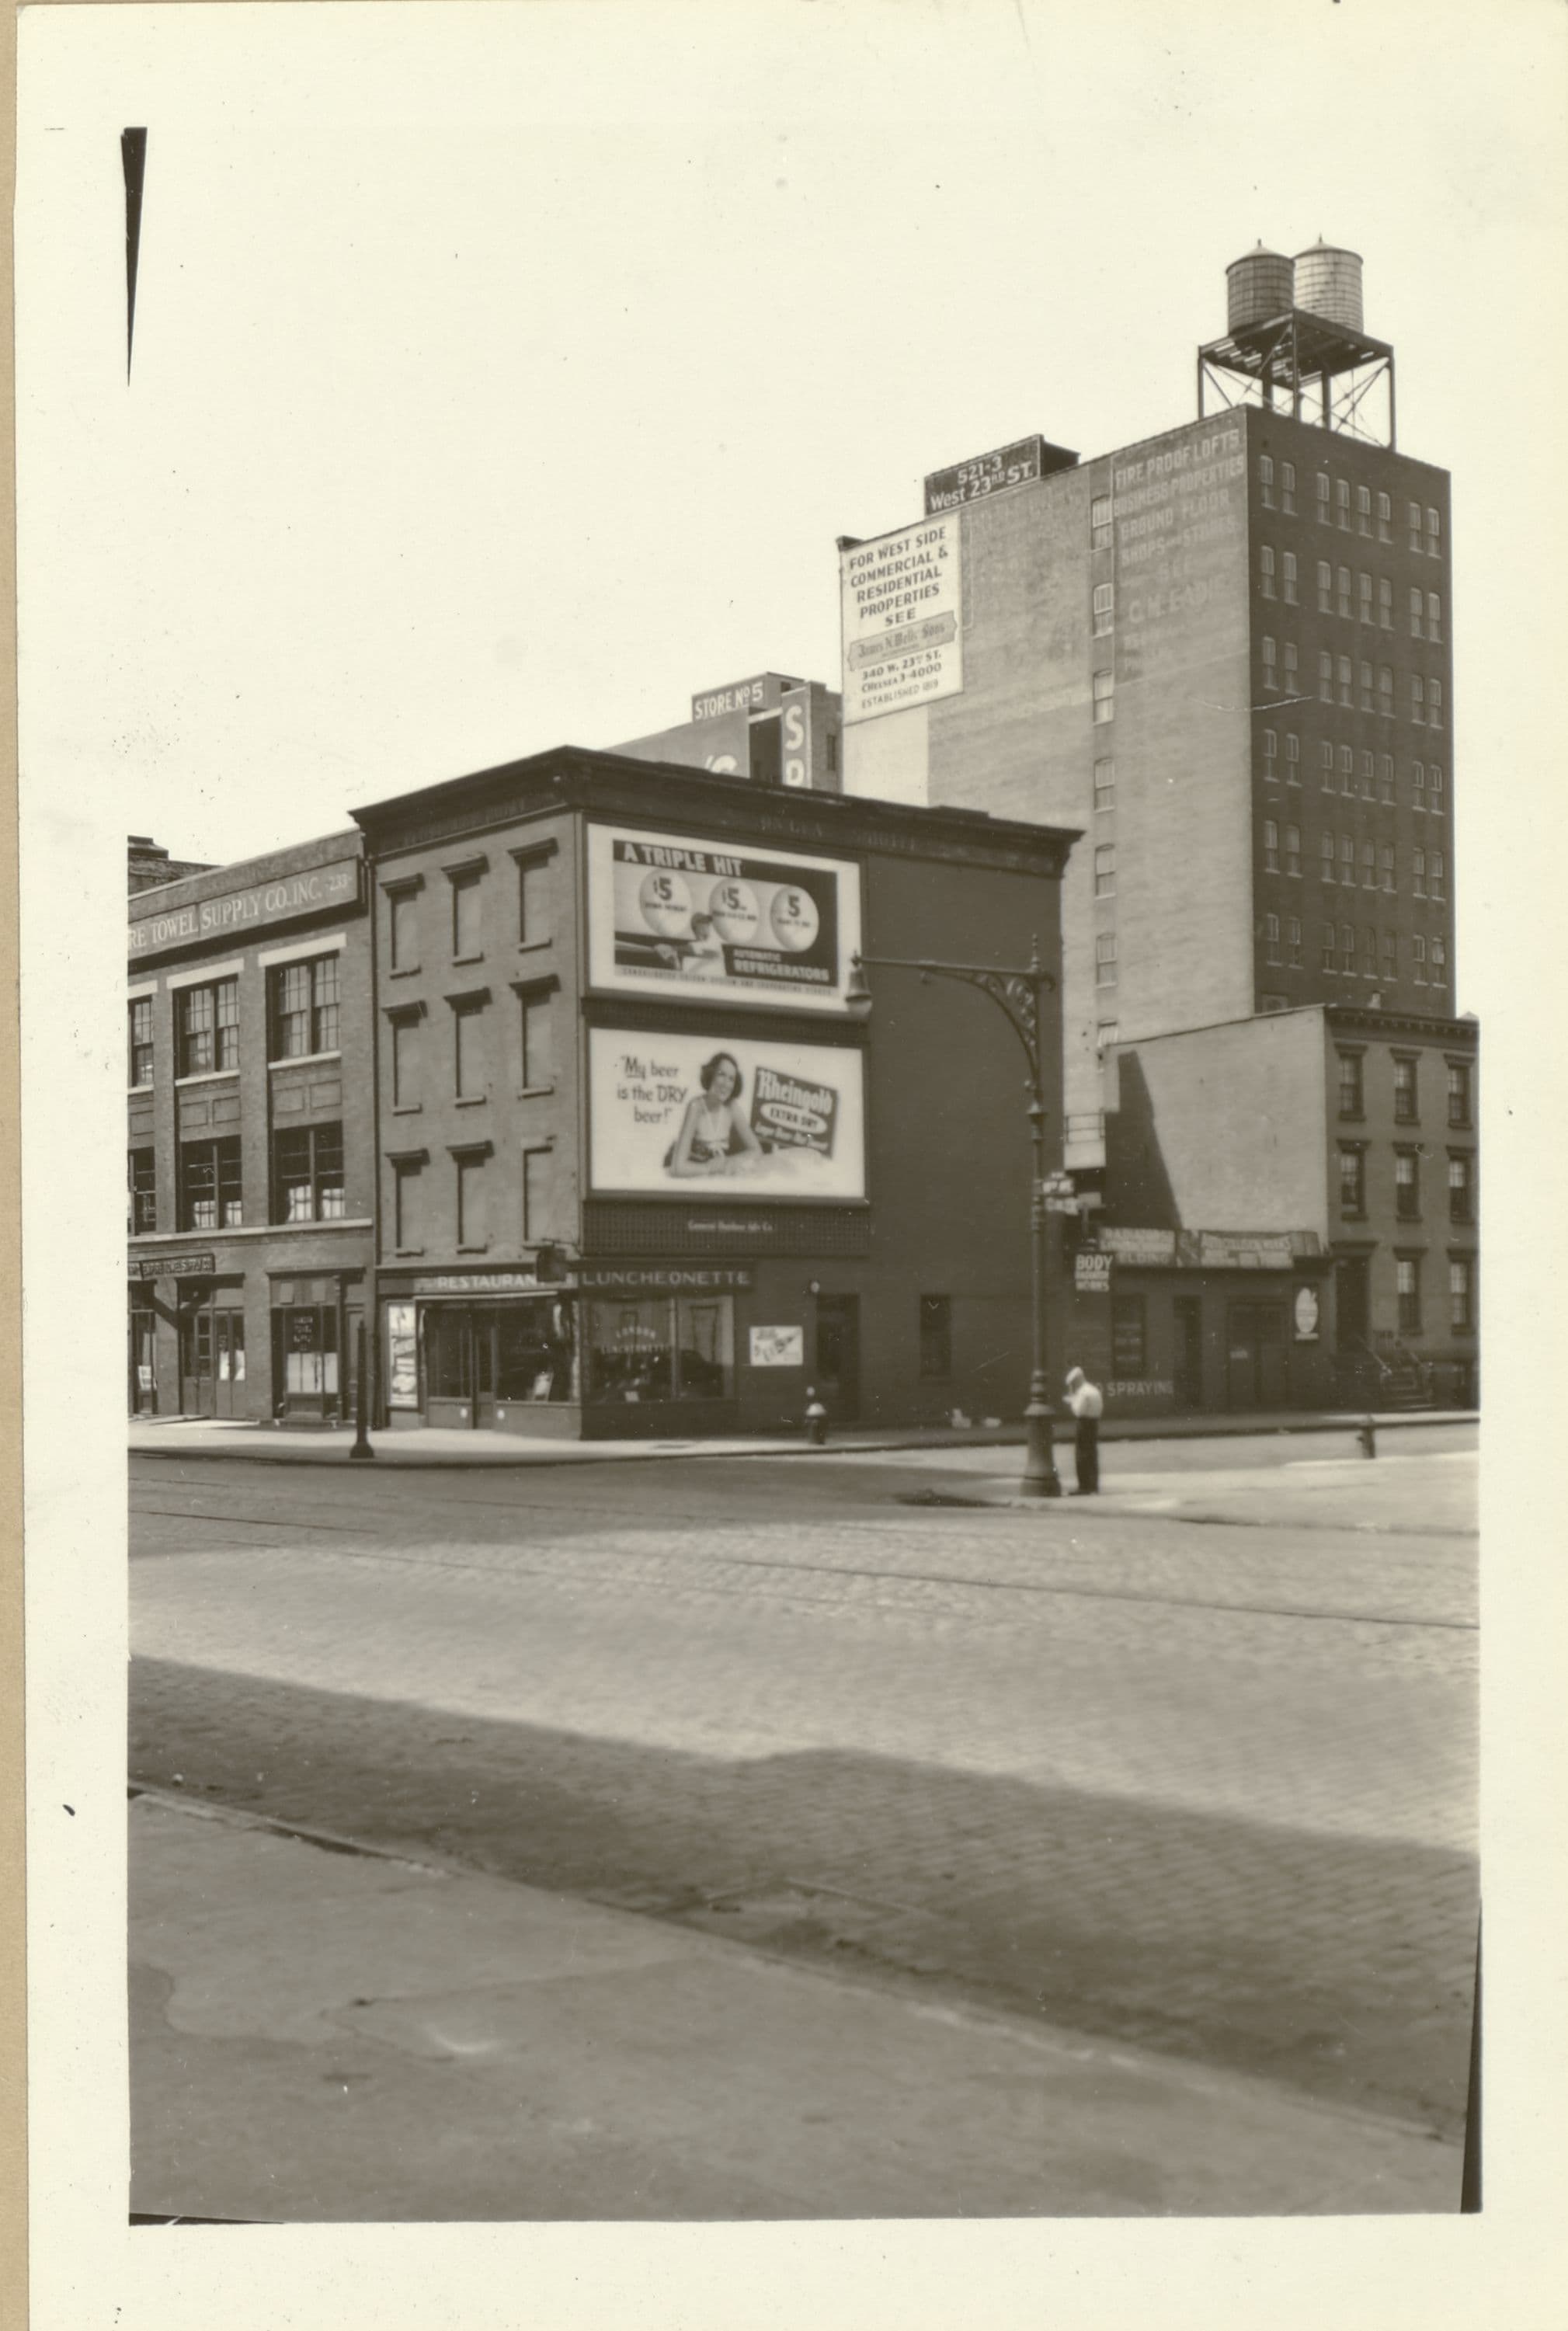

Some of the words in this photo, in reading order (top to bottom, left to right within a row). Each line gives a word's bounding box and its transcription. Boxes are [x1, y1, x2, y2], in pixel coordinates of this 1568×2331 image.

[958, 455, 1003, 484] 521-3
[1114, 462, 1144, 491] FIRE
[1146, 445, 1191, 480] PROOF
[1194, 429, 1240, 462] LOFTS
[930, 488, 965, 510] West
[1007, 461, 1033, 484] ST.
[1114, 482, 1169, 517] BUSINESS
[1170, 454, 1245, 496] PROPERTIES
[1121, 506, 1173, 541] GROUND
[1182, 488, 1230, 520] FLOOR
[850, 551, 874, 571] FOR
[878, 538, 911, 560] WEST
[916, 527, 946, 548] SIDE
[850, 550, 933, 588] COMMERCIAL
[938, 545, 948, 558] &
[857, 565, 942, 604] RESIDENTIAL
[860, 583, 940, 619] PROPERTIES
[885, 607, 916, 628] SEE
[862, 666, 884, 681] 340
[887, 663, 899, 673] W.
[925, 649, 942, 662] ST.
[695, 691, 732, 720] STORE
[752, 681, 764, 702] 5
[861, 684, 920, 709] ESTABLISHED
[624, 843, 638, 862] A
[641, 845, 706, 872] TRIPLE
[713, 856, 742, 877] HIT
[151, 911, 200, 945] TOWEL
[201, 893, 262, 931] SUPPLY
[734, 959, 831, 983] REFRIGERATORS
[650, 1058, 680, 1077] beer
[616, 1081, 629, 1101] is
[631, 1083, 654, 1101] the
[655, 1084, 688, 1103] DRY
[756, 1070, 833, 1116] Rheingold
[769, 1107, 798, 1124] EXTRA
[801, 1115, 819, 1129] DRY
[582, 1270, 752, 1286] LUNCHEONETTE
[1074, 1253, 1115, 1271] BODY
[437, 1272, 546, 1289] RESTAURAN
[1106, 1379, 1173, 1397] SPRAYING
